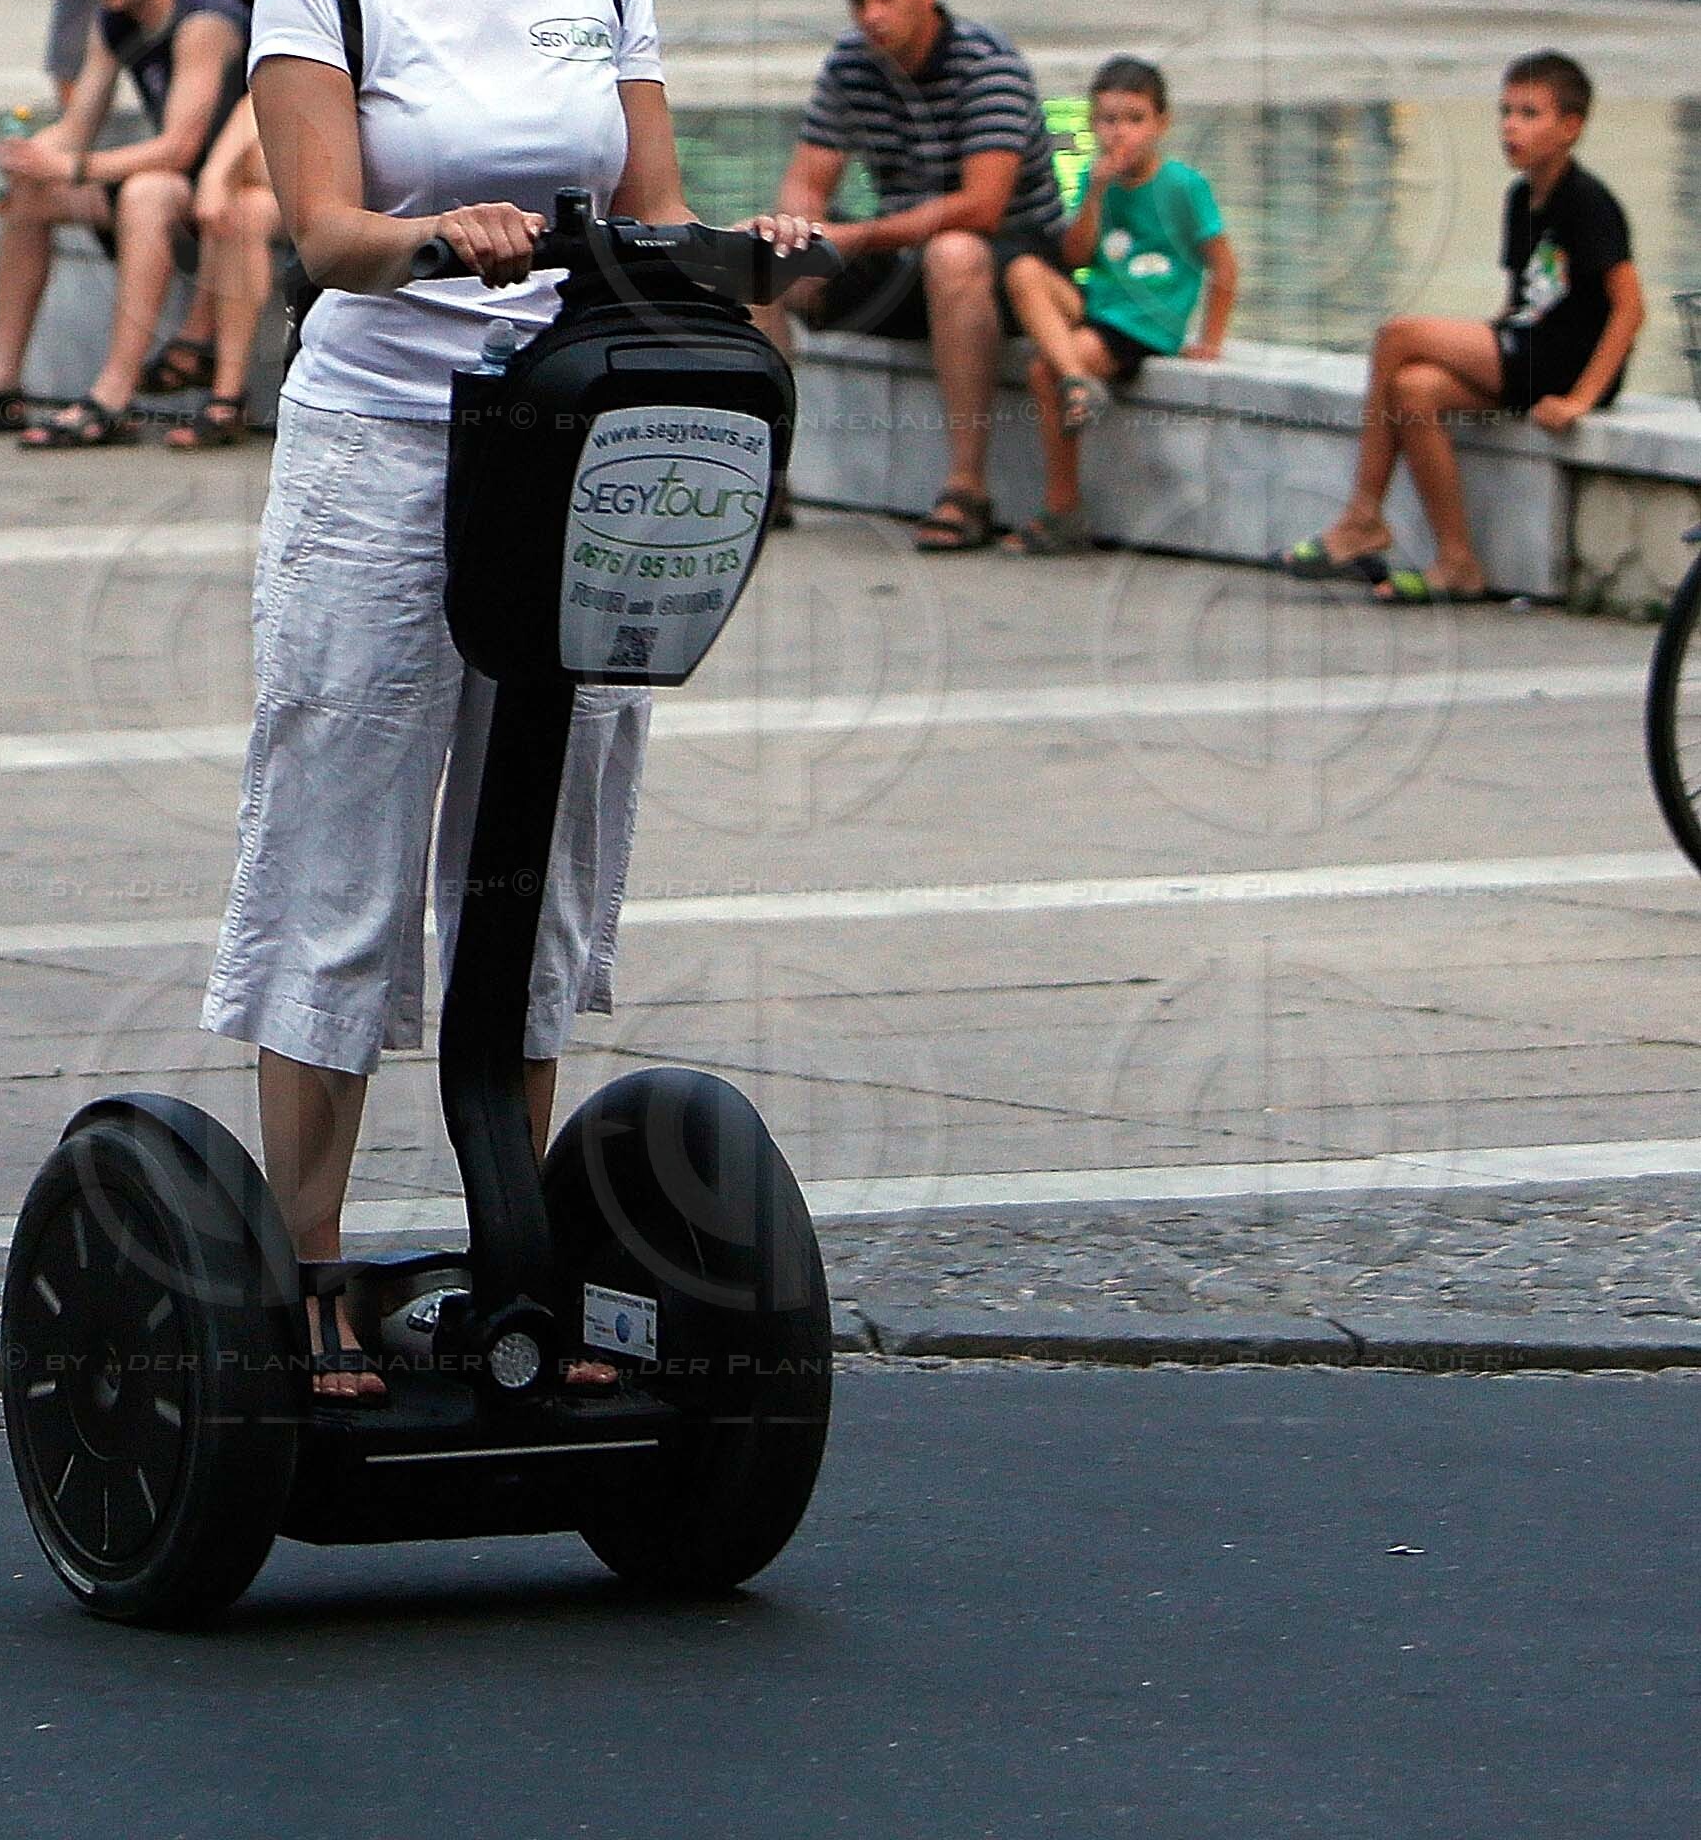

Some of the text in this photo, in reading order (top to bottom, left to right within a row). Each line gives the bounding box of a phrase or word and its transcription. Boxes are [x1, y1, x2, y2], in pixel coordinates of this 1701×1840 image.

[593, 422, 765, 455] www.segytours.at
[638, 555, 666, 578] 95
[669, 555, 697, 578] 30
[703, 548, 740, 575] 123
